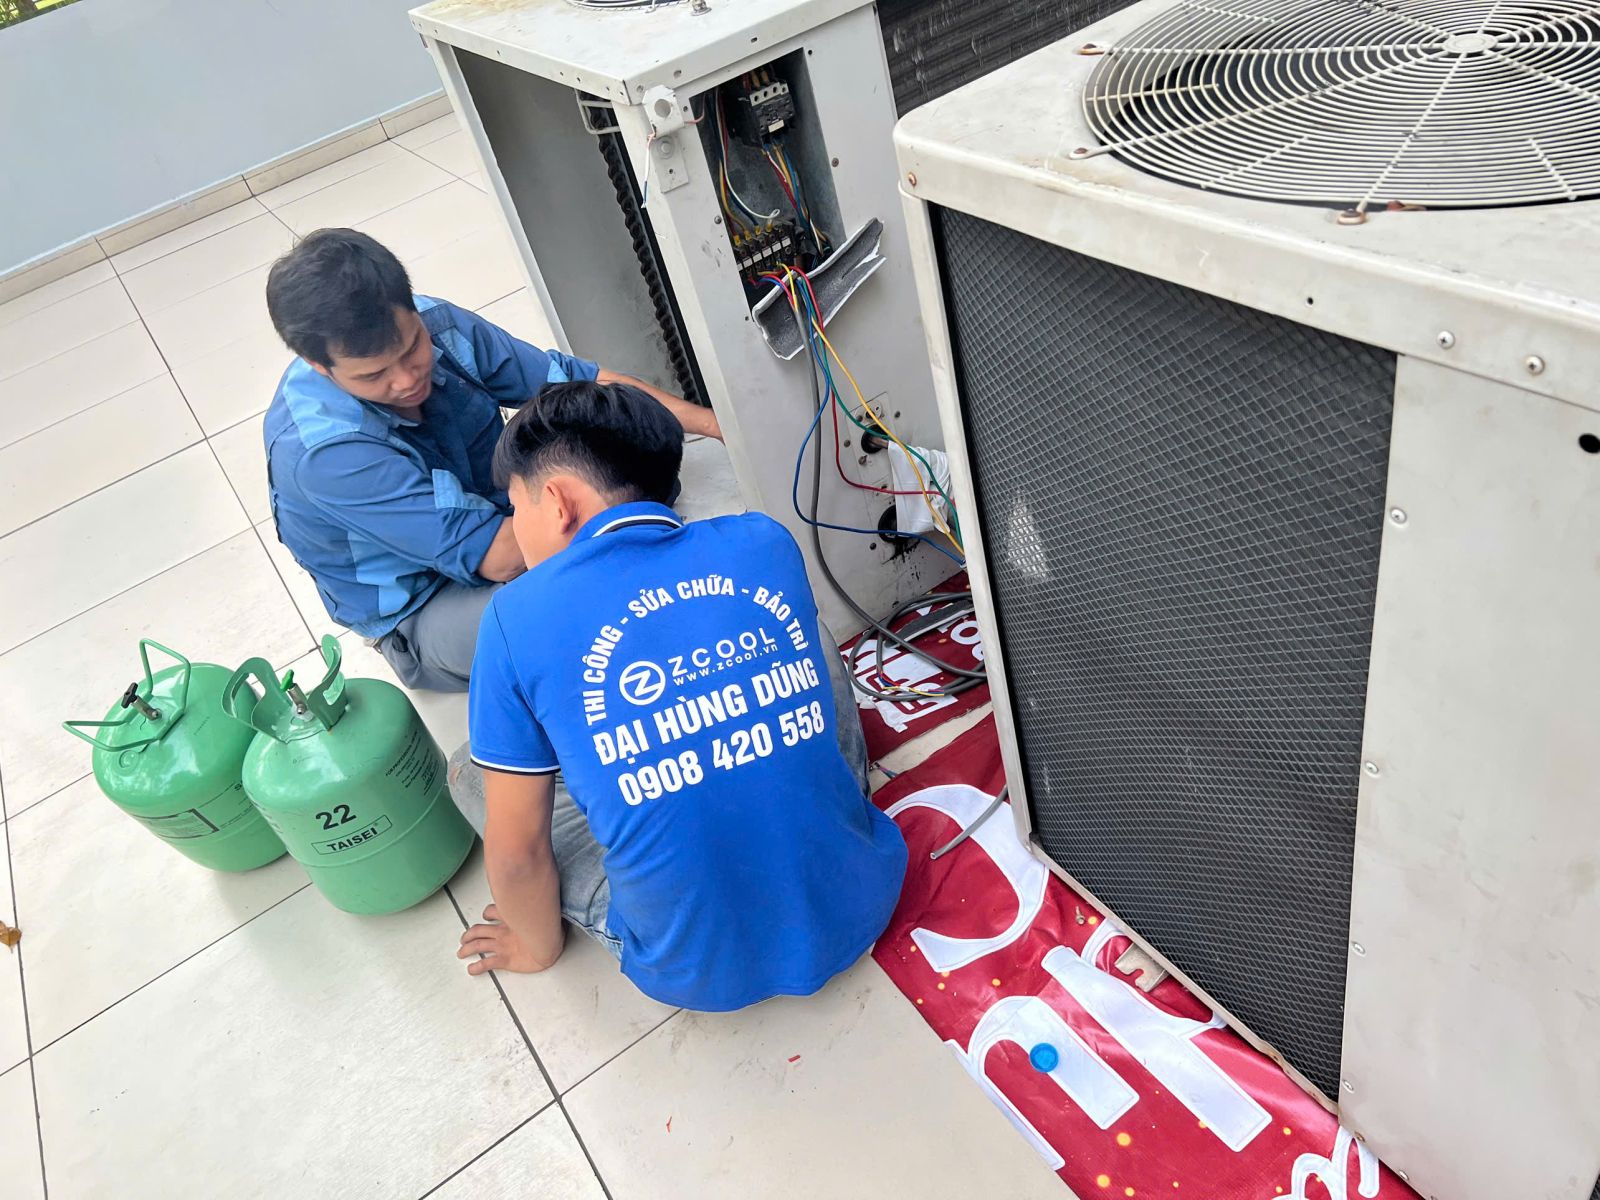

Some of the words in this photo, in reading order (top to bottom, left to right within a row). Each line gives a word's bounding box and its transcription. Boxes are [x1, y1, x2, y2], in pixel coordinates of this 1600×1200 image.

[628, 588, 675, 618] SỬA
[676, 574, 735, 600] CHỮA
[753, 586, 791, 621] BẢO
[785, 617, 809, 651] TRÌ
[582, 625, 624, 683] CÔNG
[667, 627, 775, 678] ZCOOL
[673, 643, 778, 686] www.zcool.vn
[583, 689, 606, 726] THI
[593, 720, 650, 765] ĐẠI
[653, 683, 749, 745] HÙNG
[752, 657, 820, 707] DŨNG
[617, 750, 704, 806] 0908
[712, 722, 774, 771] 420
[778, 700, 825, 747] 558
[315, 804, 357, 830] 22
[326, 827, 378, 851] TAISEI
